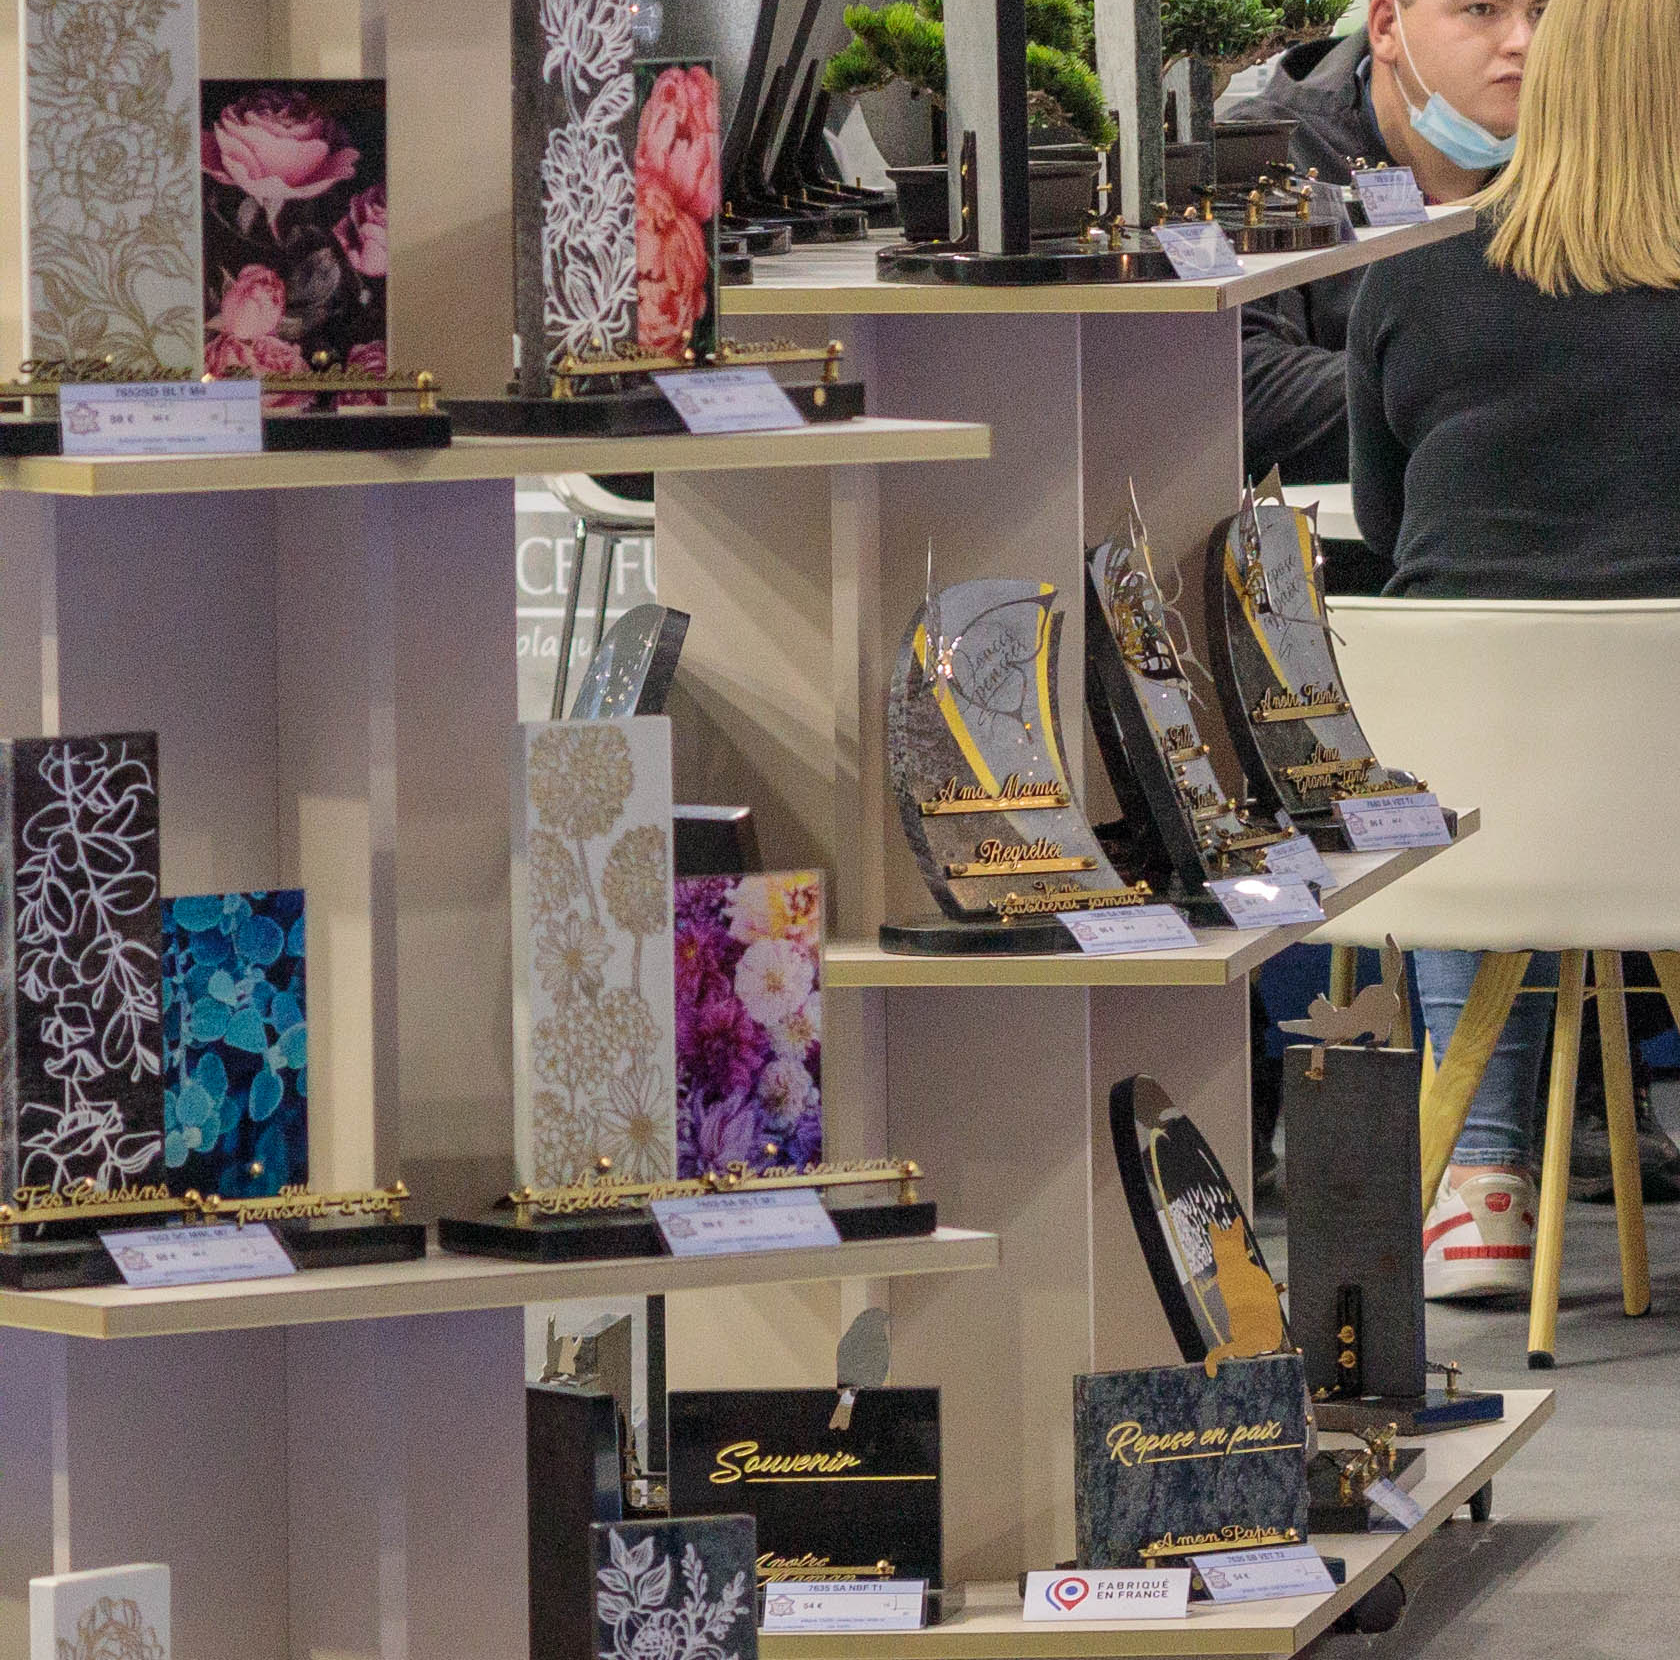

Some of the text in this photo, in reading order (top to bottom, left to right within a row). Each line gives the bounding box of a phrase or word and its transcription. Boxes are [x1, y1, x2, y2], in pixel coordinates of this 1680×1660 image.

[1106, 1419, 1283, 1467] Repose en paix
[708, 1440, 861, 1484] Souvenir
[1156, 1524, 1280, 1549] A mon Papa
[808, 1584, 830, 1593] 7635
[1097, 1577, 1170, 1591] FABRIQUÉ
[1096, 1590, 1170, 1601] EN FRANCE
